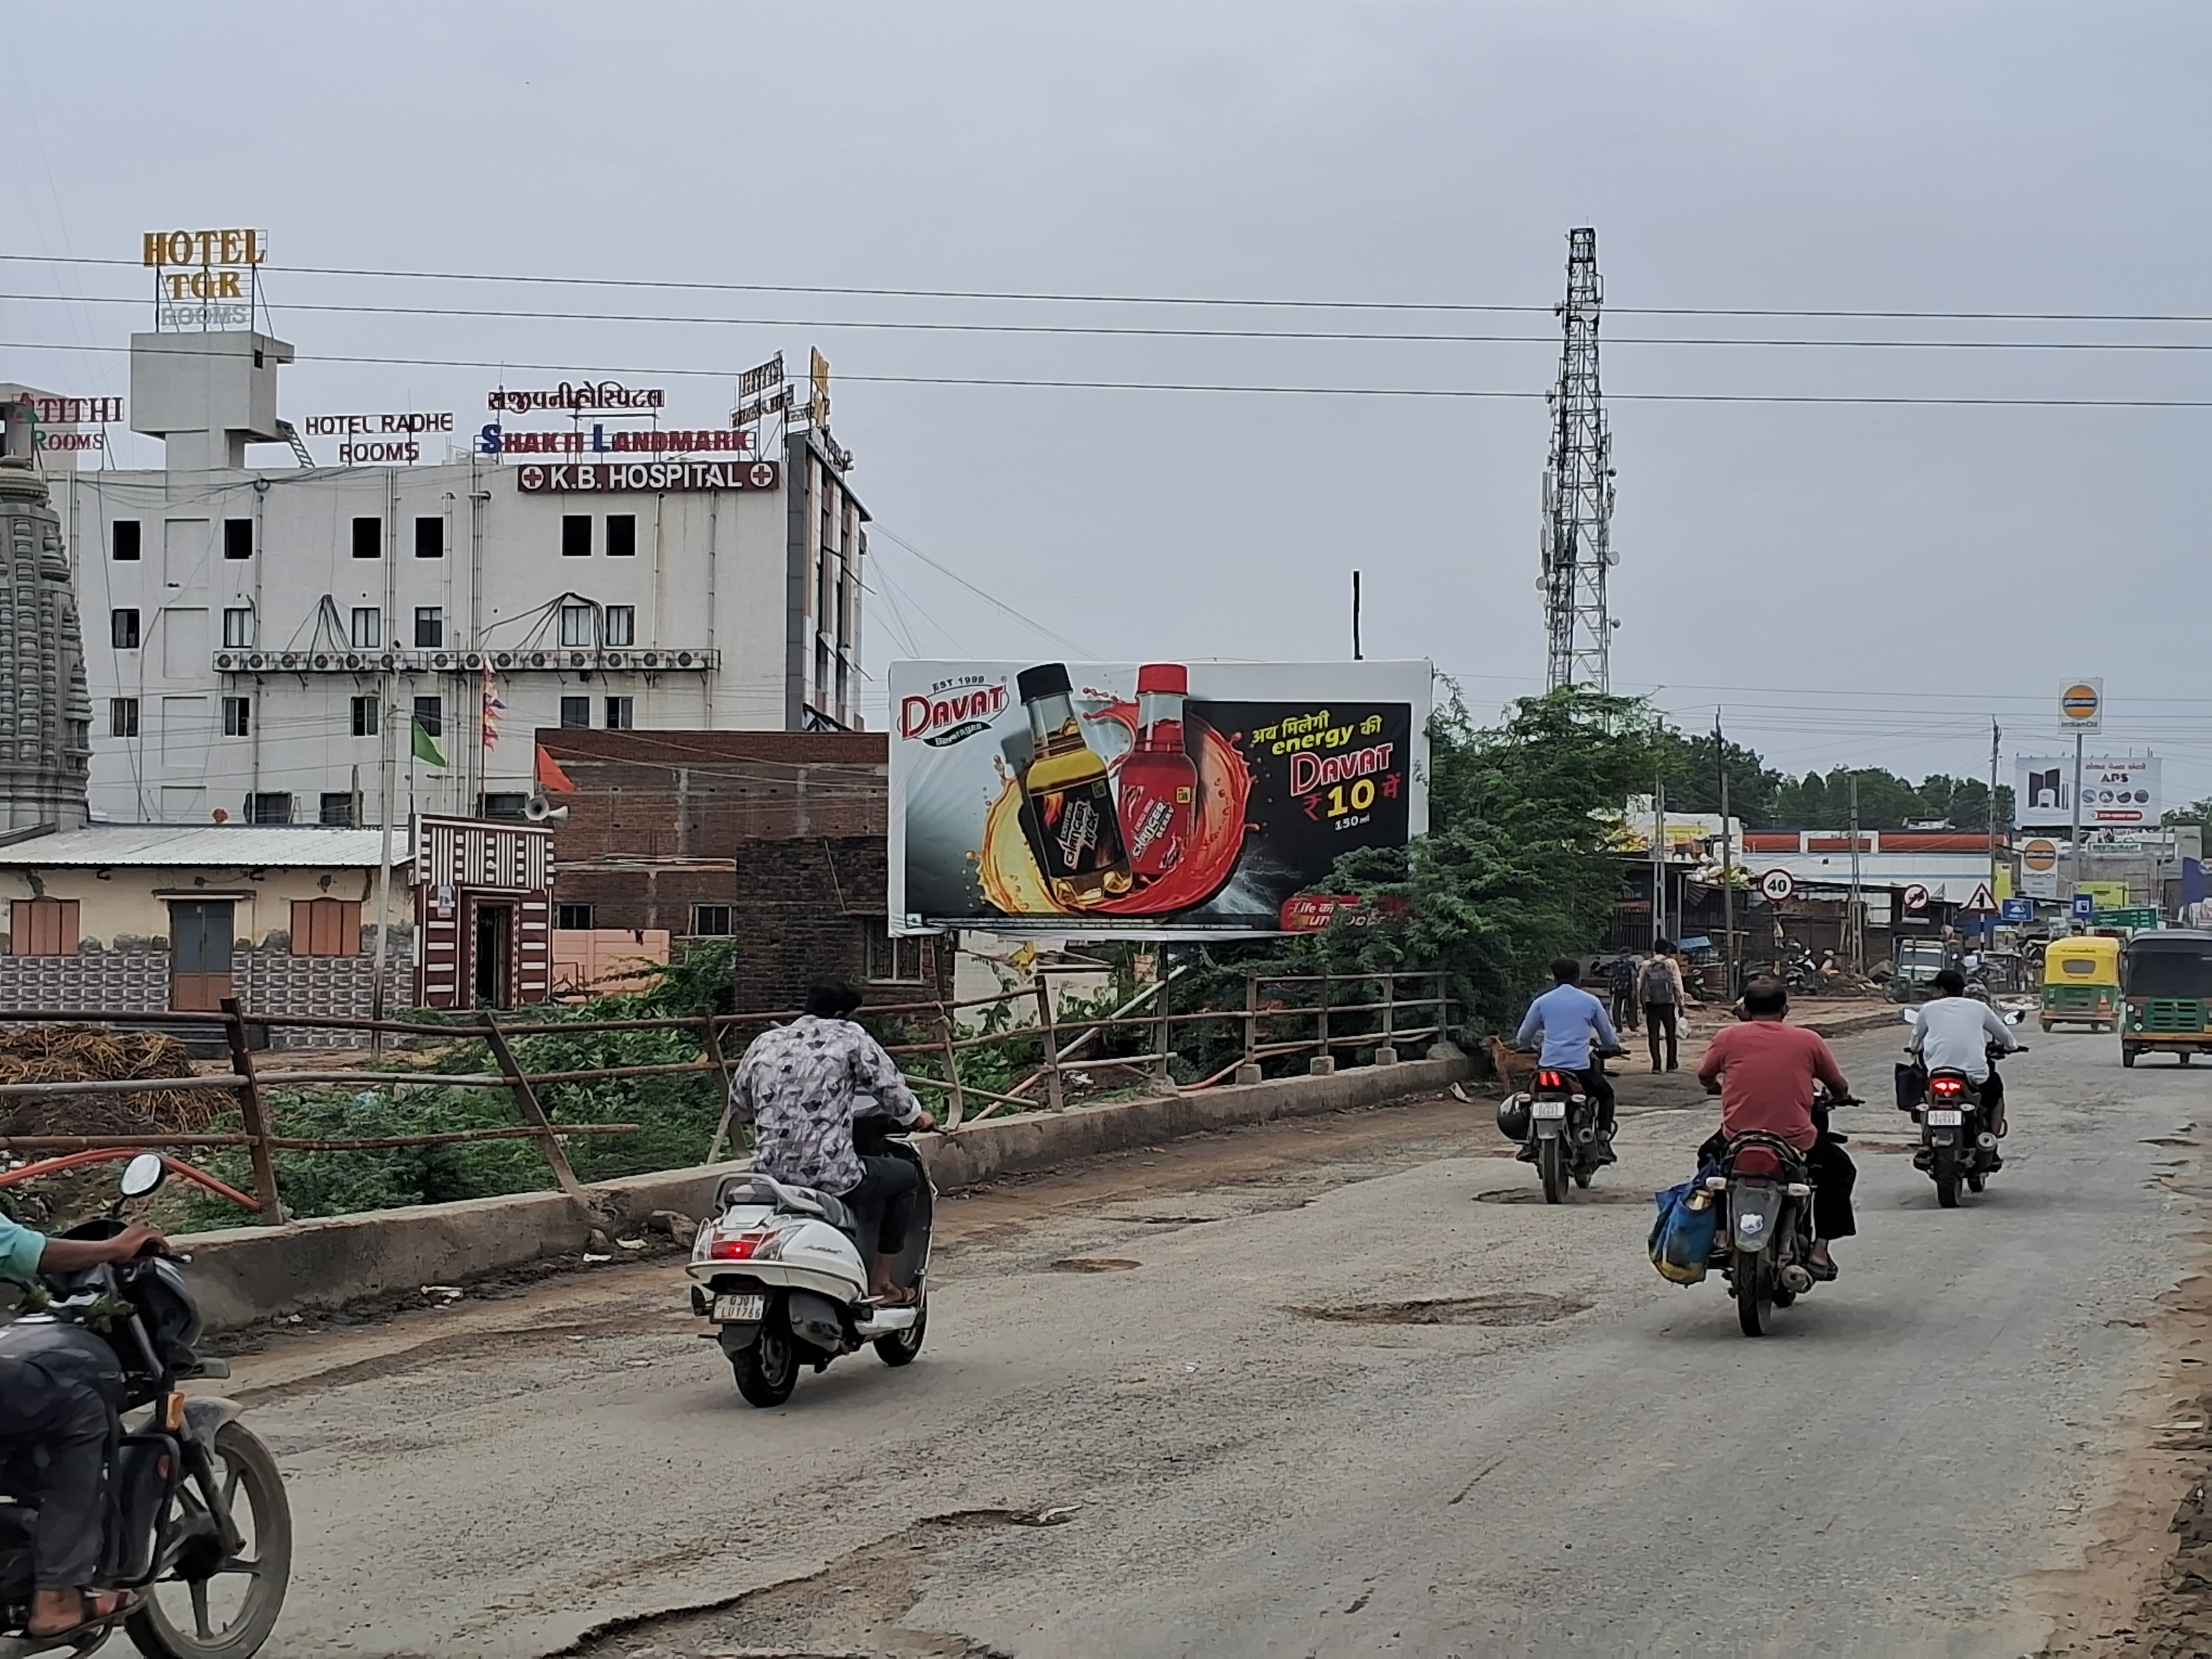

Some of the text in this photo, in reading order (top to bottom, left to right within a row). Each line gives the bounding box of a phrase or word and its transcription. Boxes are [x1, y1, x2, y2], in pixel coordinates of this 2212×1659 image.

[144, 229, 266, 266] HOTEL
[166, 271, 243, 300] TGR
[161, 306, 247, 326] ROOMS
[306, 413, 453, 434] HOTEL RADHE
[481, 423, 748, 453] SHAKTI LANDMARK
[31, 430, 104, 451] ROOMS
[339, 442, 420, 461] ROOMS
[550, 464, 743, 489] K.B. HOSPITAL
[932, 678, 953, 691] EST
[902, 685, 1005, 740] DAVAT
[1252, 710, 1330, 743] अब मिलेगी
[1272, 715, 1382, 755] energy की
[1290, 742, 1393, 796] DAVAT
[1328, 779, 1375, 818] 10
[1767, 878, 1787, 892] 40
